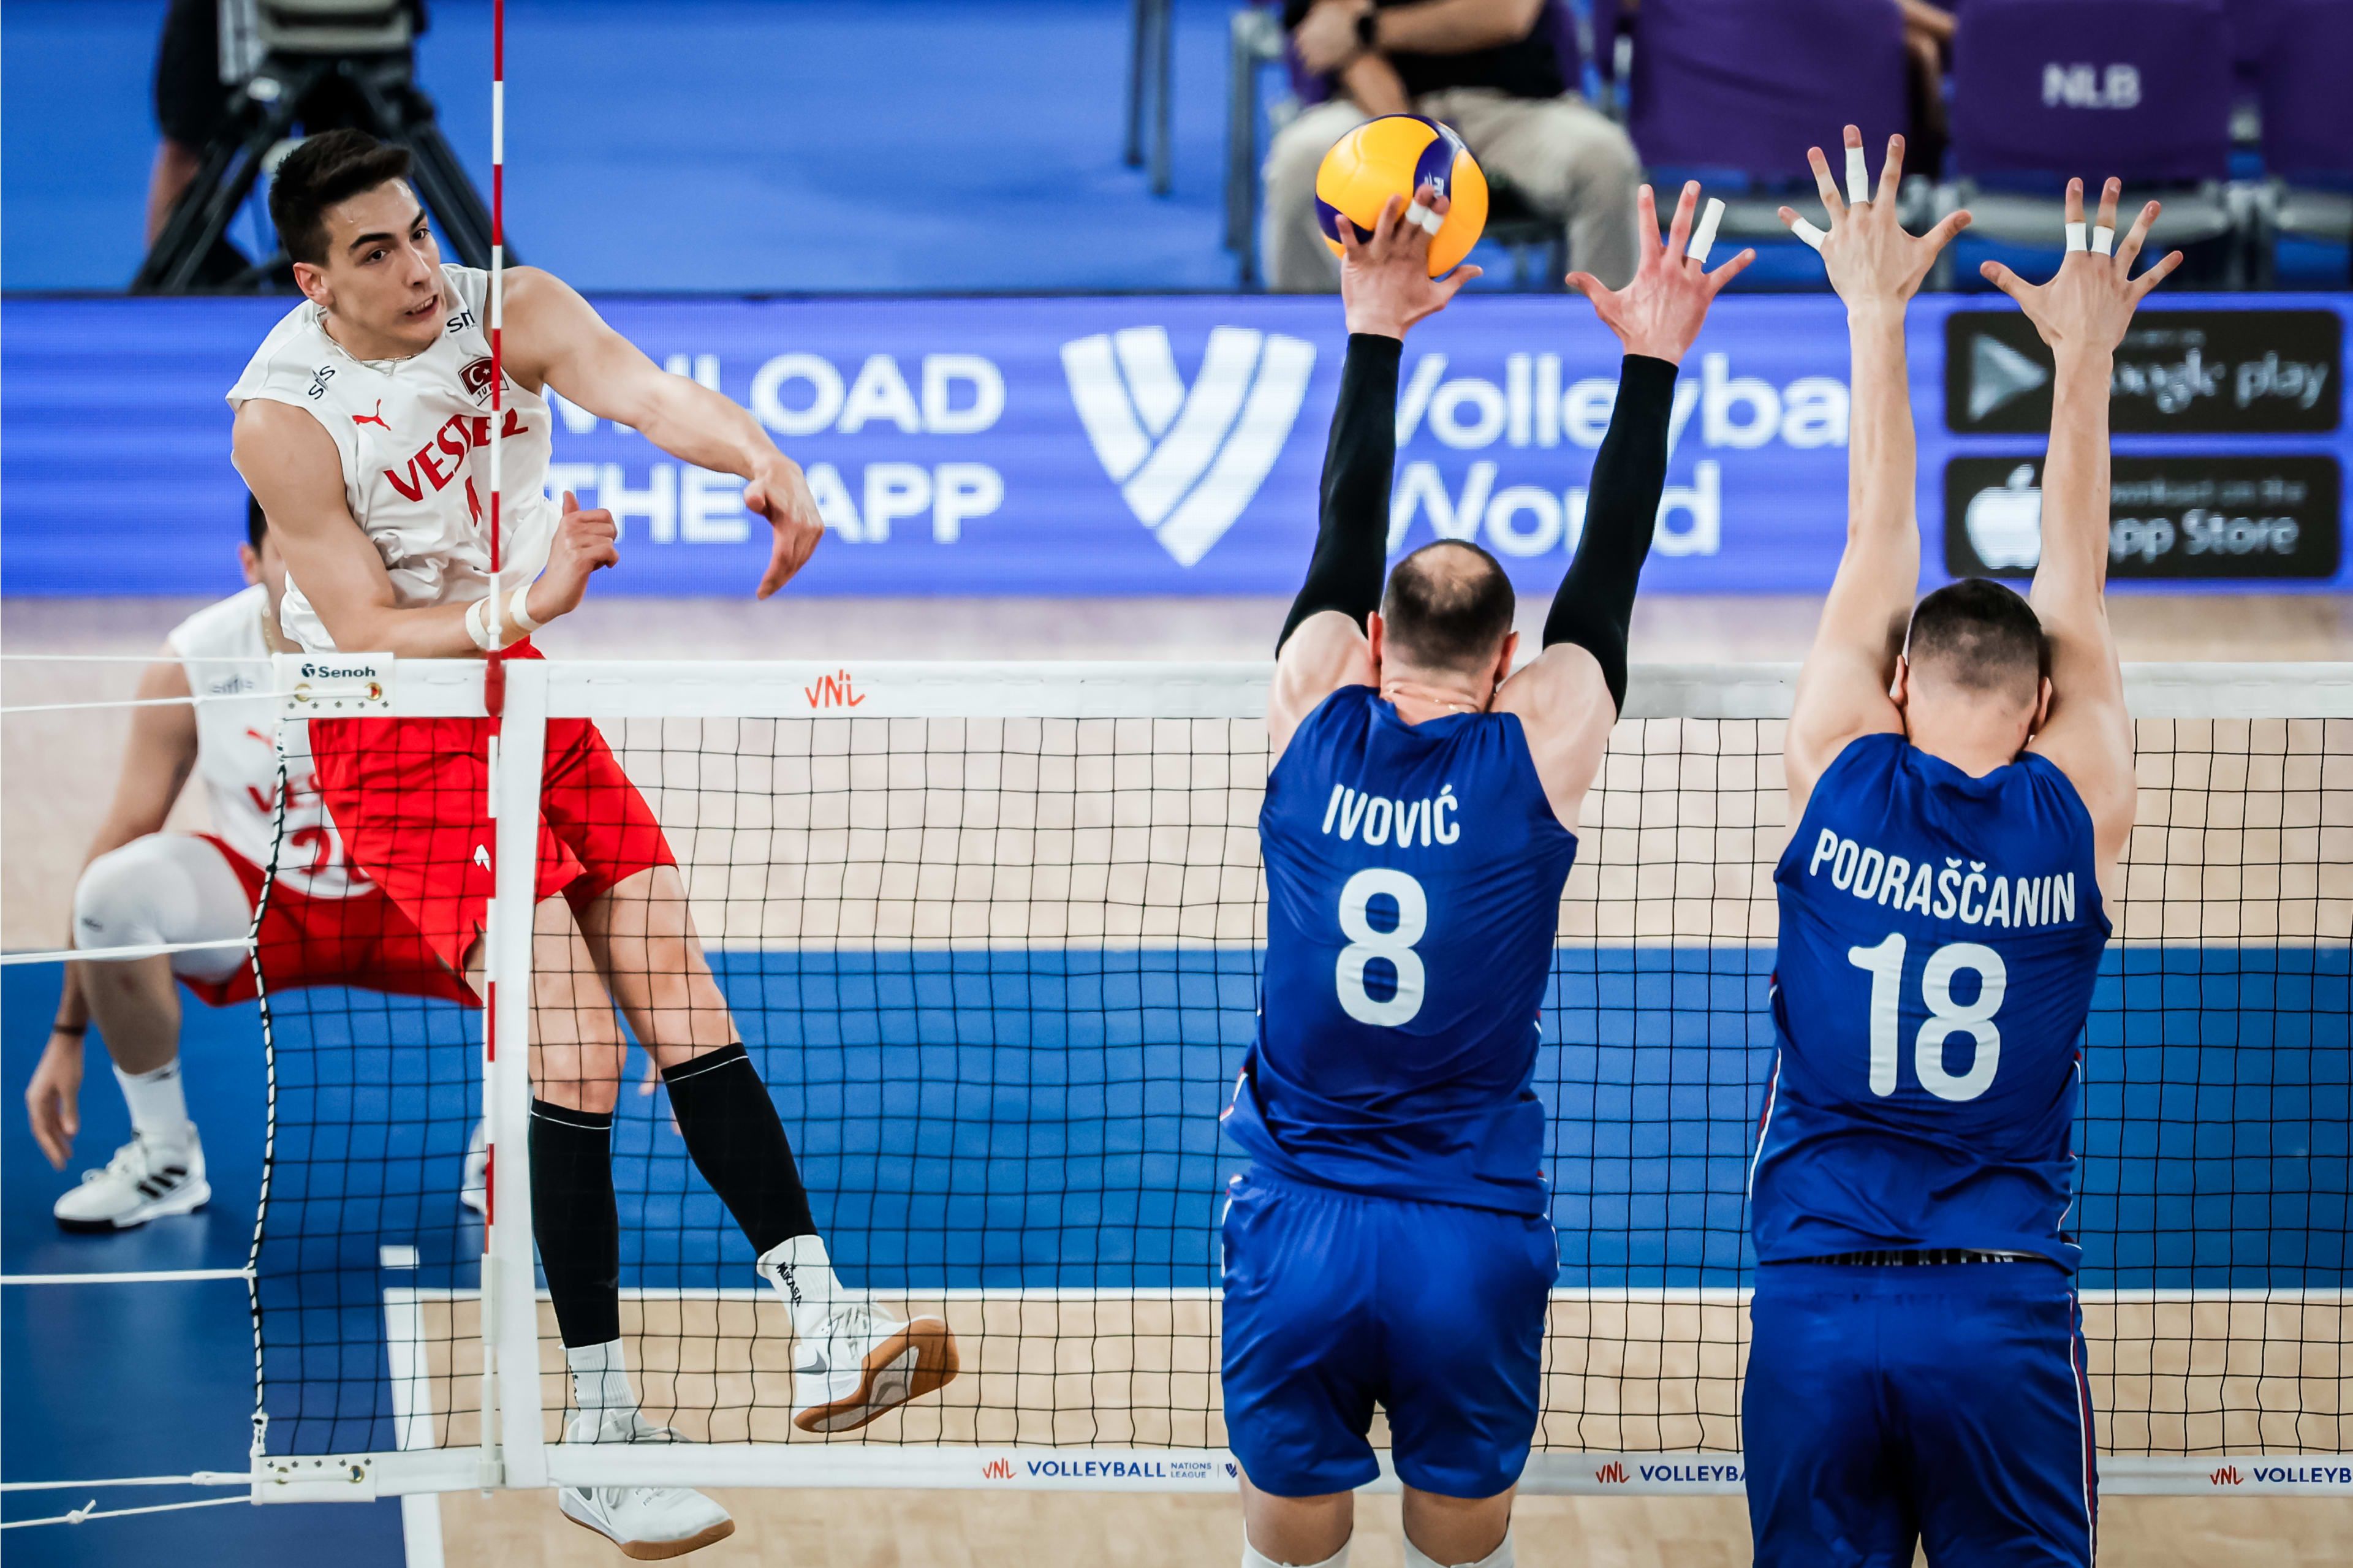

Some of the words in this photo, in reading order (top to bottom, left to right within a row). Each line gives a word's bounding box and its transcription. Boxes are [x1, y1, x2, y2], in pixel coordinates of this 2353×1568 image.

[2043, 63, 2141, 108] NLB
[2235, 350, 2328, 411] play
[544, 463, 751, 543] THE
[805, 462, 1006, 543] APP
[1386, 461, 1721, 556] Word
[2110, 518, 2175, 562] pp
[2181, 508, 2299, 554] Store
[319, 665, 376, 678] Senoh
[805, 669, 865, 708] VNL
[1322, 784, 1460, 848] IVOVIĆ
[1809, 828, 2075, 928] PODRAŠČANIN
[1336, 868, 1427, 1026] 8
[1848, 932, 2007, 1101] 18
[982, 1458, 1017, 1479] VNL
[1028, 1461, 1166, 1477] VOLLEYBALL
[1596, 1461, 1630, 1483] VNL
[2210, 1465, 2244, 1485] VNL
[2253, 1468, 2352, 1483] VOLLEYB
